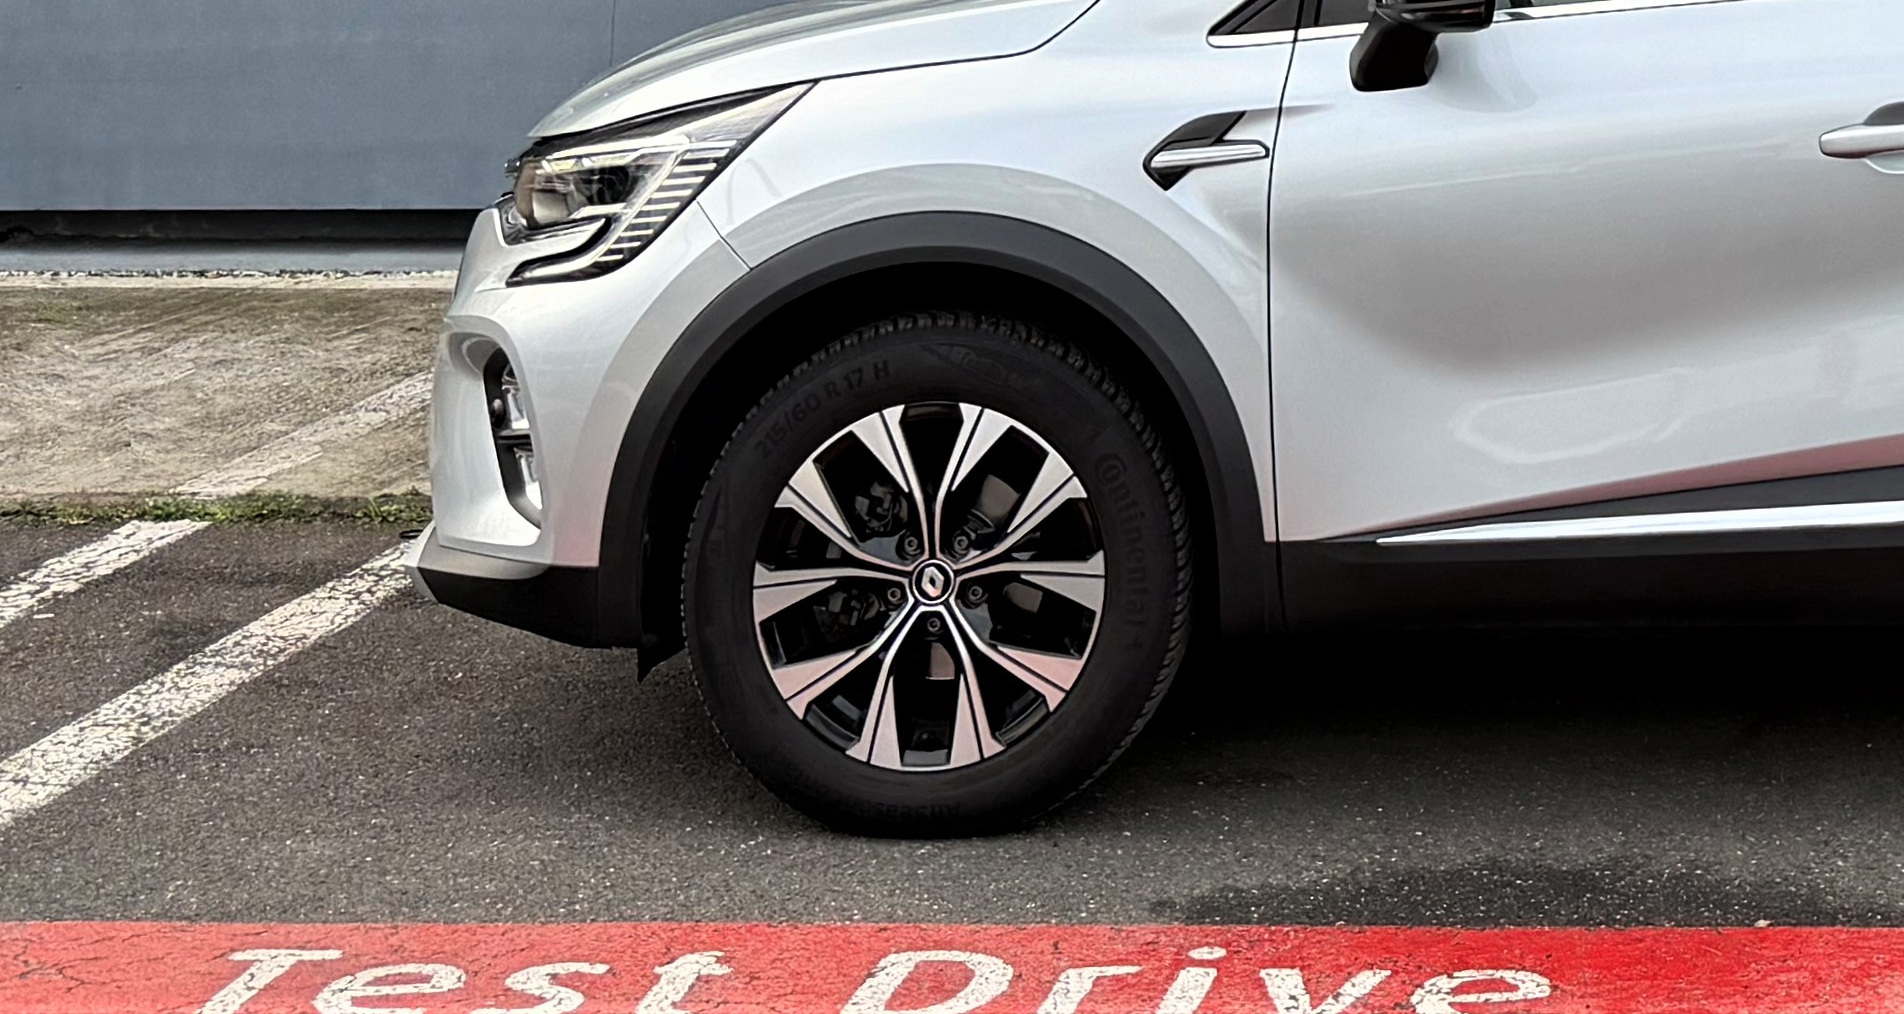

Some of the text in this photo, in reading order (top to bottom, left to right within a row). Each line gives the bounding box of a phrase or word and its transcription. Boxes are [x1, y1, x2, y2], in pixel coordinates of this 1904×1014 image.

[872, 359, 891, 380] H
[196, 945, 1552, 1014] Test Drive
